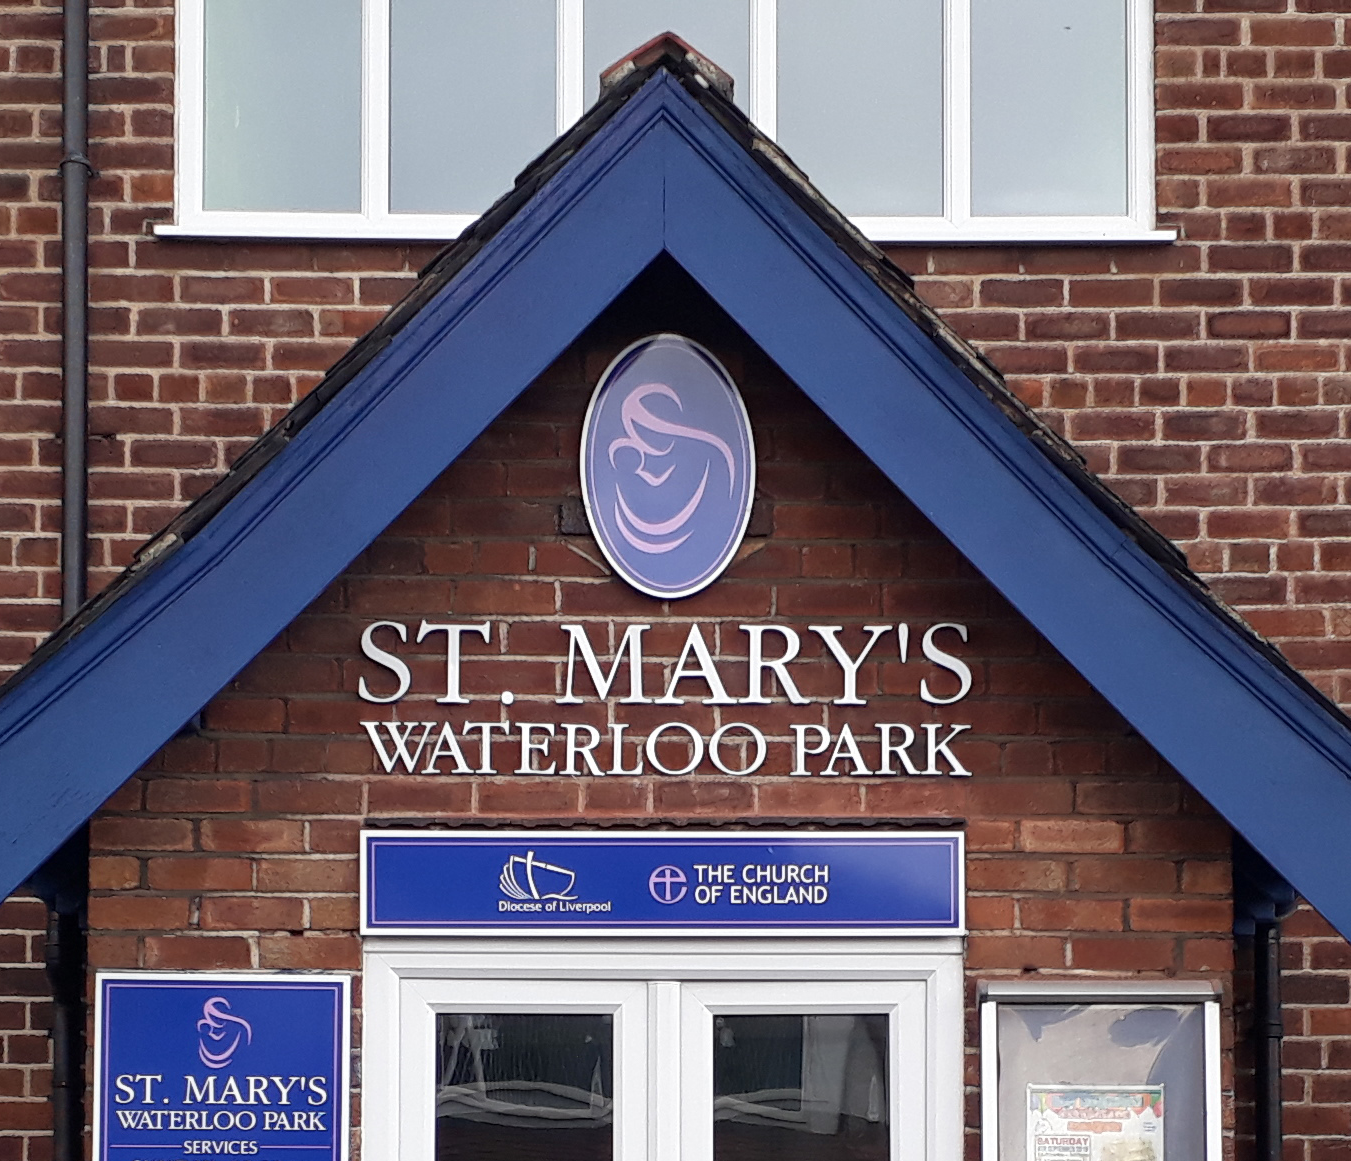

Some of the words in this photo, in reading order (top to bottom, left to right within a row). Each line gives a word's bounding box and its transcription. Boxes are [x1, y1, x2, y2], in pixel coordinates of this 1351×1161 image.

[358, 620, 514, 705] ST.
[555, 621, 973, 706] MARY'S
[360, 720, 768, 776] WATERLOO
[789, 723, 973, 777] PARK
[694, 864, 736, 883] THE
[742, 864, 830, 884] CHURCH
[694, 885, 724, 905] OF
[730, 885, 828, 905] ENGLAND
[498, 901, 543, 913] Diocese
[545, 901, 559, 913] of
[559, 901, 612, 914] Liverpool
[114, 1073, 170, 1105] ST.
[182, 1075, 328, 1106] MARY'S
[115, 1110, 257, 1131] WATERLOO
[262, 1111, 327, 1131] PARK
[183, 1140, 259, 1155] SERVICES
[1037, 1137, 1089, 1145] SATURDAY
